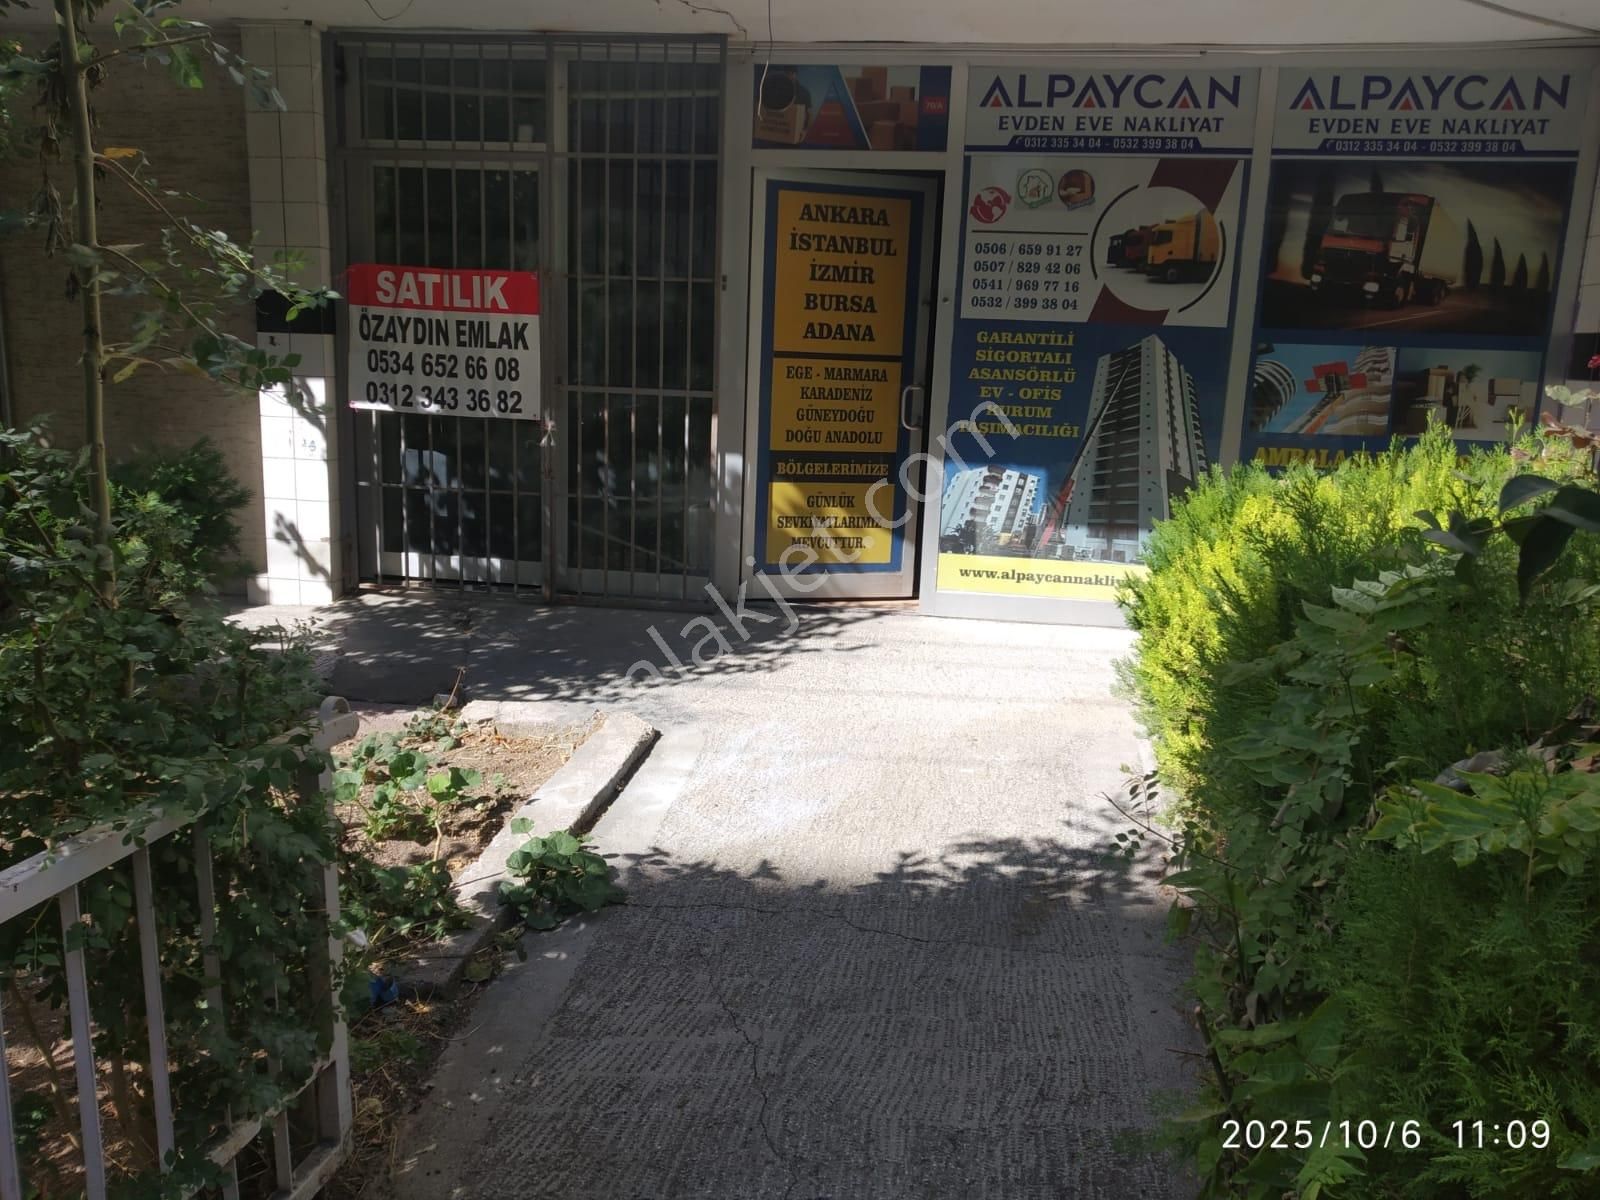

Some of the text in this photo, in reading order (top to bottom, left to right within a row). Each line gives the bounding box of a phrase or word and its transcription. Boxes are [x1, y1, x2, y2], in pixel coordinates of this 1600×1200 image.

[979, 74, 1242, 110] ALPAYCAN
[1288, 75, 1572, 111] ALPAYCAN
[998, 116, 1066, 132] EVDEN
[1076, 116, 1114, 132] EVE
[1308, 118, 1381, 134] EVDEN
[1391, 118, 1431, 134] EVE
[1024, 137, 1048, 149] 0312
[1051, 138, 1070, 149] 335
[1072, 138, 1085, 149] 34
[1088, 138, 1102, 149] 04
[1113, 138, 1139, 150] 0532
[1142, 138, 1162, 150] 399
[1165, 138, 1178, 150] 38
[1181, 139, 1195, 150] 04
[1335, 141, 1361, 152] 0312
[1363, 141, 1384, 152] 335
[1386, 141, 1400, 152] 34
[1403, 141, 1417, 152] 04
[1429, 141, 1457, 153] 0532
[1460, 141, 1482, 153] 399
[1485, 141, 1499, 153] 38
[1502, 141, 1516, 153] 04
[799, 203, 890, 227] ANKARA
[789, 227, 897, 257] İSTANBUL
[975, 243, 1007, 255] 0506
[1018, 244, 1042, 256] 659
[1046, 245, 1061, 256] 91
[1066, 245, 1083, 257] 27
[809, 258, 875, 285] İZMİR
[974, 260, 1006, 273] 0507
[1016, 262, 1041, 274] 829
[1045, 263, 1061, 274] 42
[1065, 263, 1081, 275] 06
[375, 270, 510, 310] SATILIK
[972, 278, 1003, 291] 0541
[1015, 279, 1039, 291] 969
[1043, 281, 1060, 292] 77
[1063, 281, 1080, 293] 16
[803, 292, 878, 314] BURSA
[971, 296, 1003, 308] 0532
[1014, 297, 1038, 309] 399
[1042, 298, 1058, 310] 38
[1061, 299, 1078, 310] 04
[358, 308, 530, 351] ÖZAYDIN EMLAK
[802, 322, 876, 343] ADANA
[976, 329, 1075, 346] GARANTİLİ
[367, 348, 520, 382] 0534 652 66 08
[975, 347, 1073, 365] SİGORTALI
[786, 366, 813, 381] EGE
[824, 367, 889, 382] MARMARA
[968, 367, 1077, 383] ASANSÖRLÜ
[366, 381, 523, 414] 0312 343 36 82
[800, 384, 873, 401] KARADENİZ
[980, 386, 1004, 399] EV
[1019, 386, 1062, 401] OFİS
[796, 405, 875, 424] GÜNEYDOĞU
[986, 405, 1053, 419] KURUM
[785, 426, 883, 445] DOĞU ANADOLU
[776, 458, 889, 477] BÖLGELERİMİZE
[806, 491, 855, 509] GÜNLÜK
